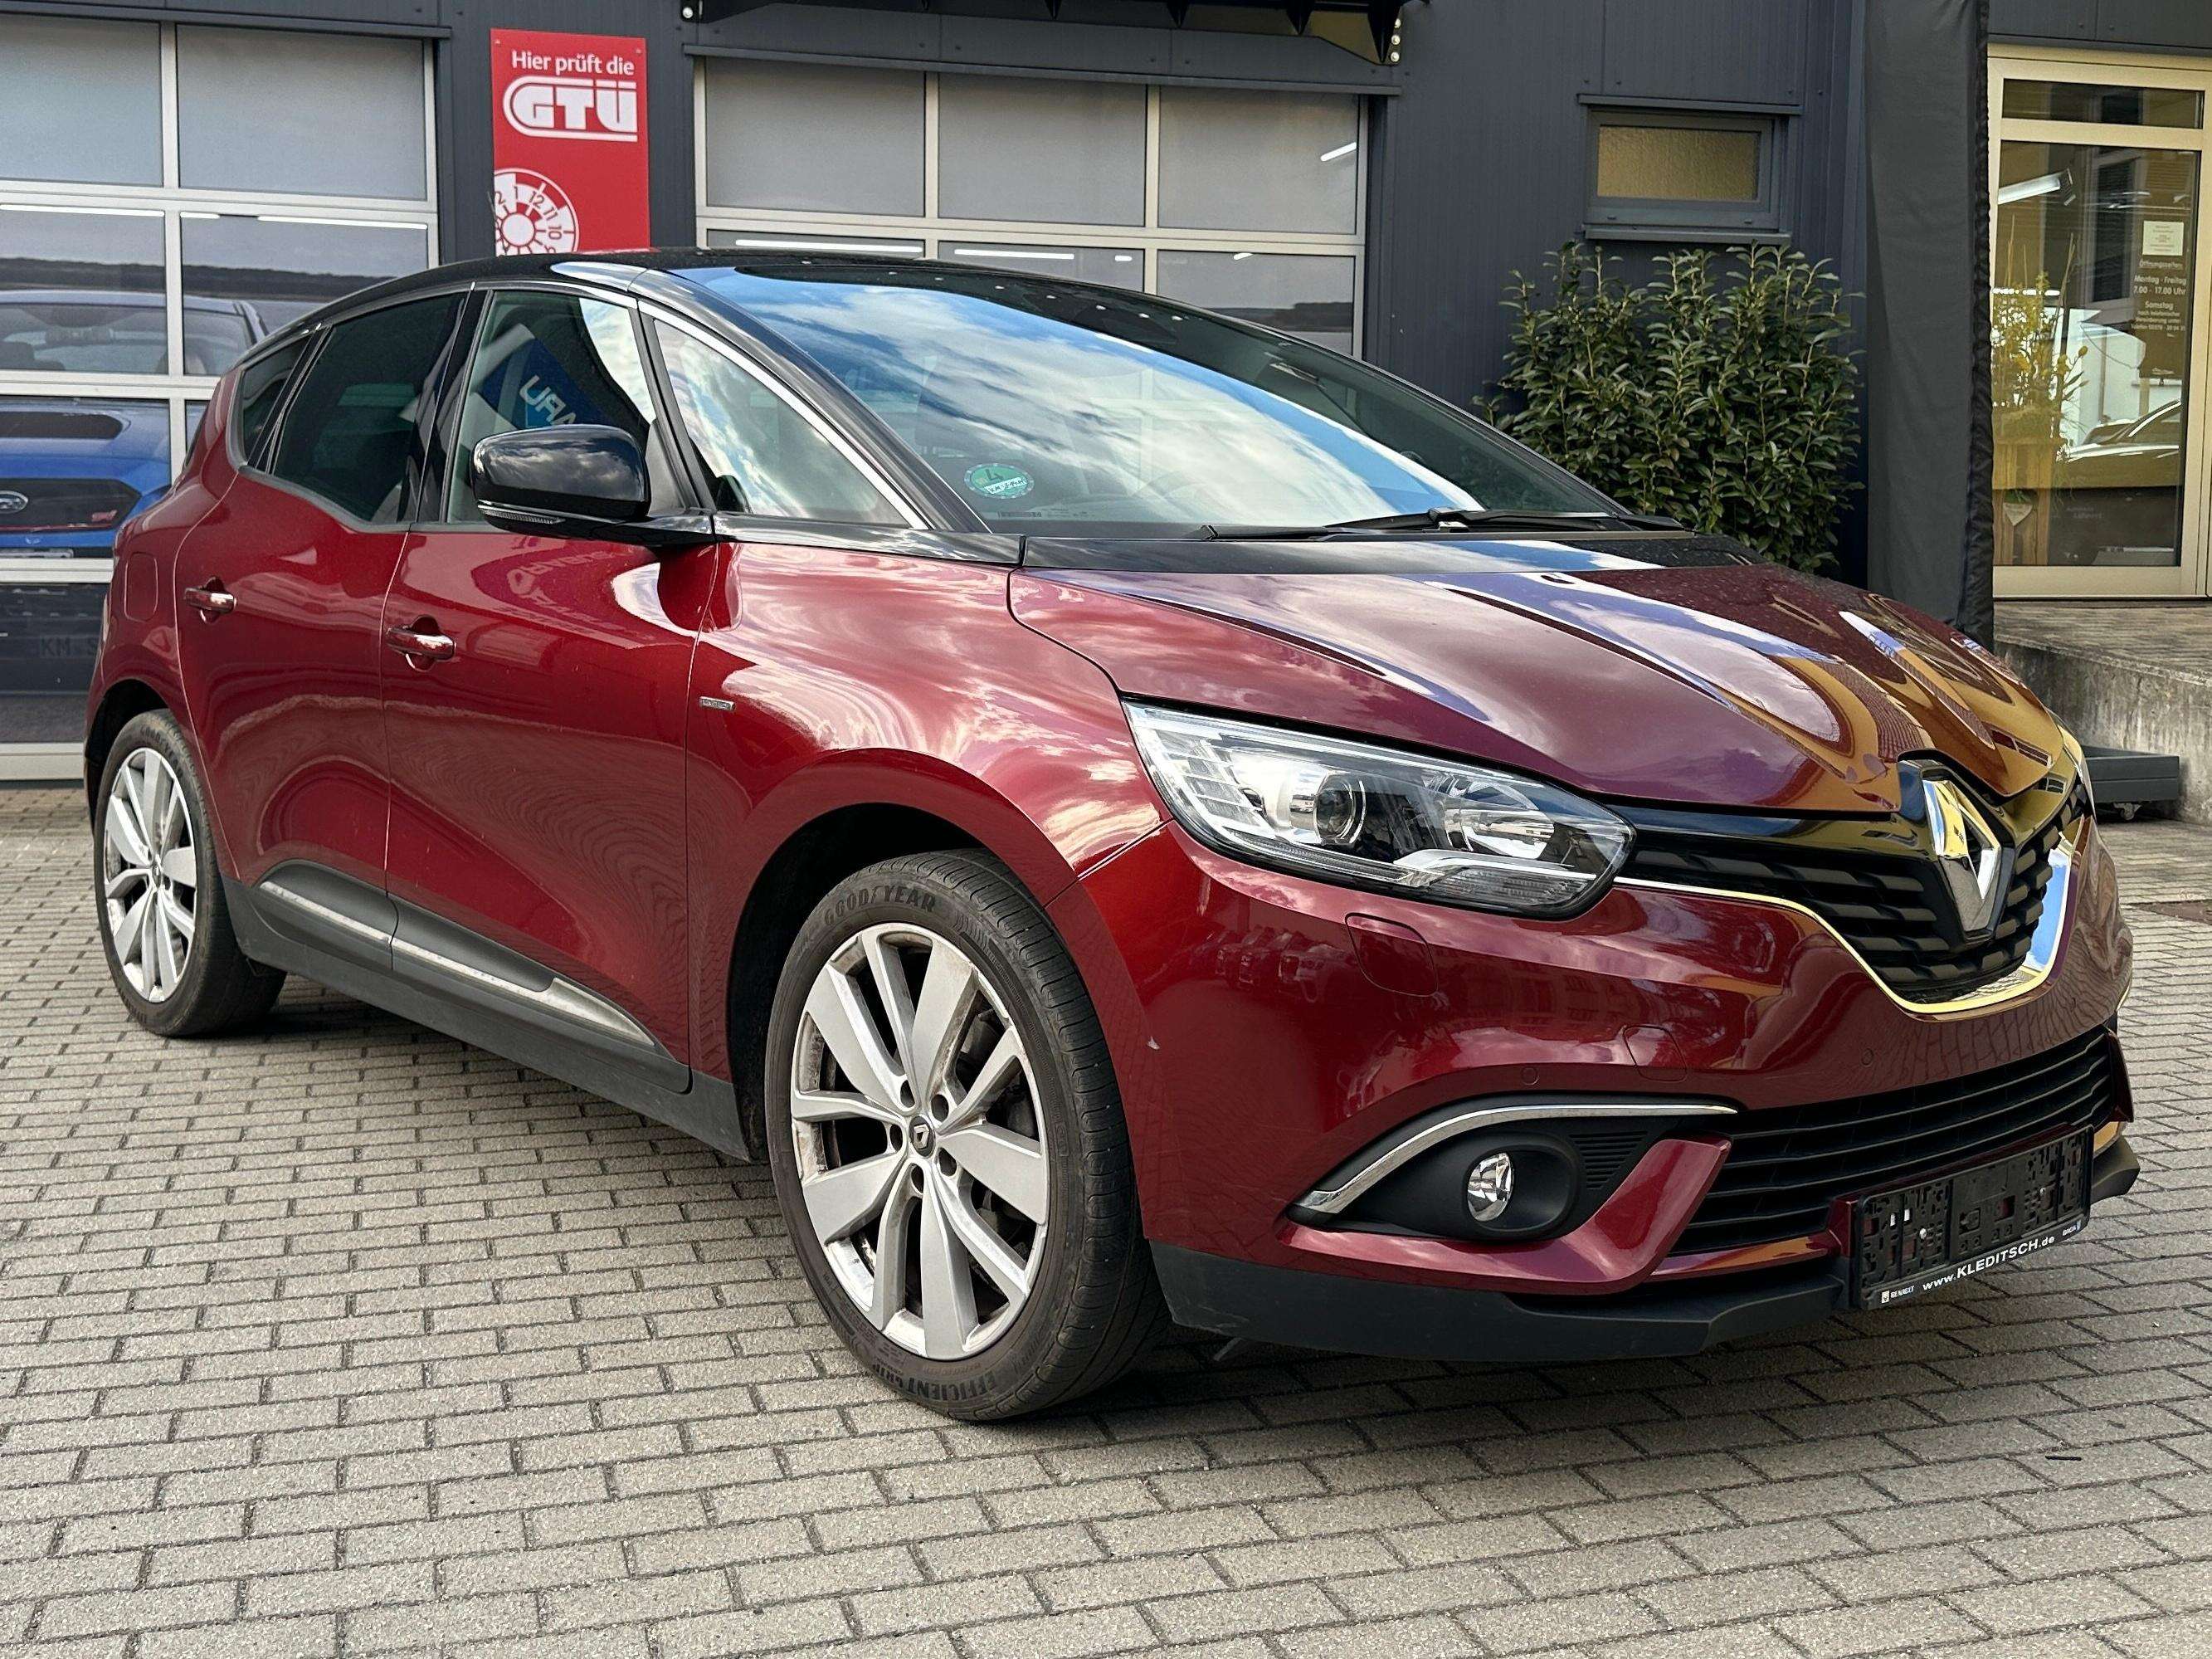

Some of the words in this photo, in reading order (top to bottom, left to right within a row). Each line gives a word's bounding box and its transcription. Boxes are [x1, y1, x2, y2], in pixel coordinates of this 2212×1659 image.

[511, 50, 551, 71] Hier
[555, 53, 602, 76] prüft
[606, 56, 635, 76] die
[503, 76, 638, 142] GTÜ
[529, 190, 545, 209] 12
[543, 207, 558, 221] 11
[548, 225, 563, 240] 10
[2173, 287, 2186, 295] Uhr
[1922, 1235, 2055, 1291] www.KLEDITSCH.de
